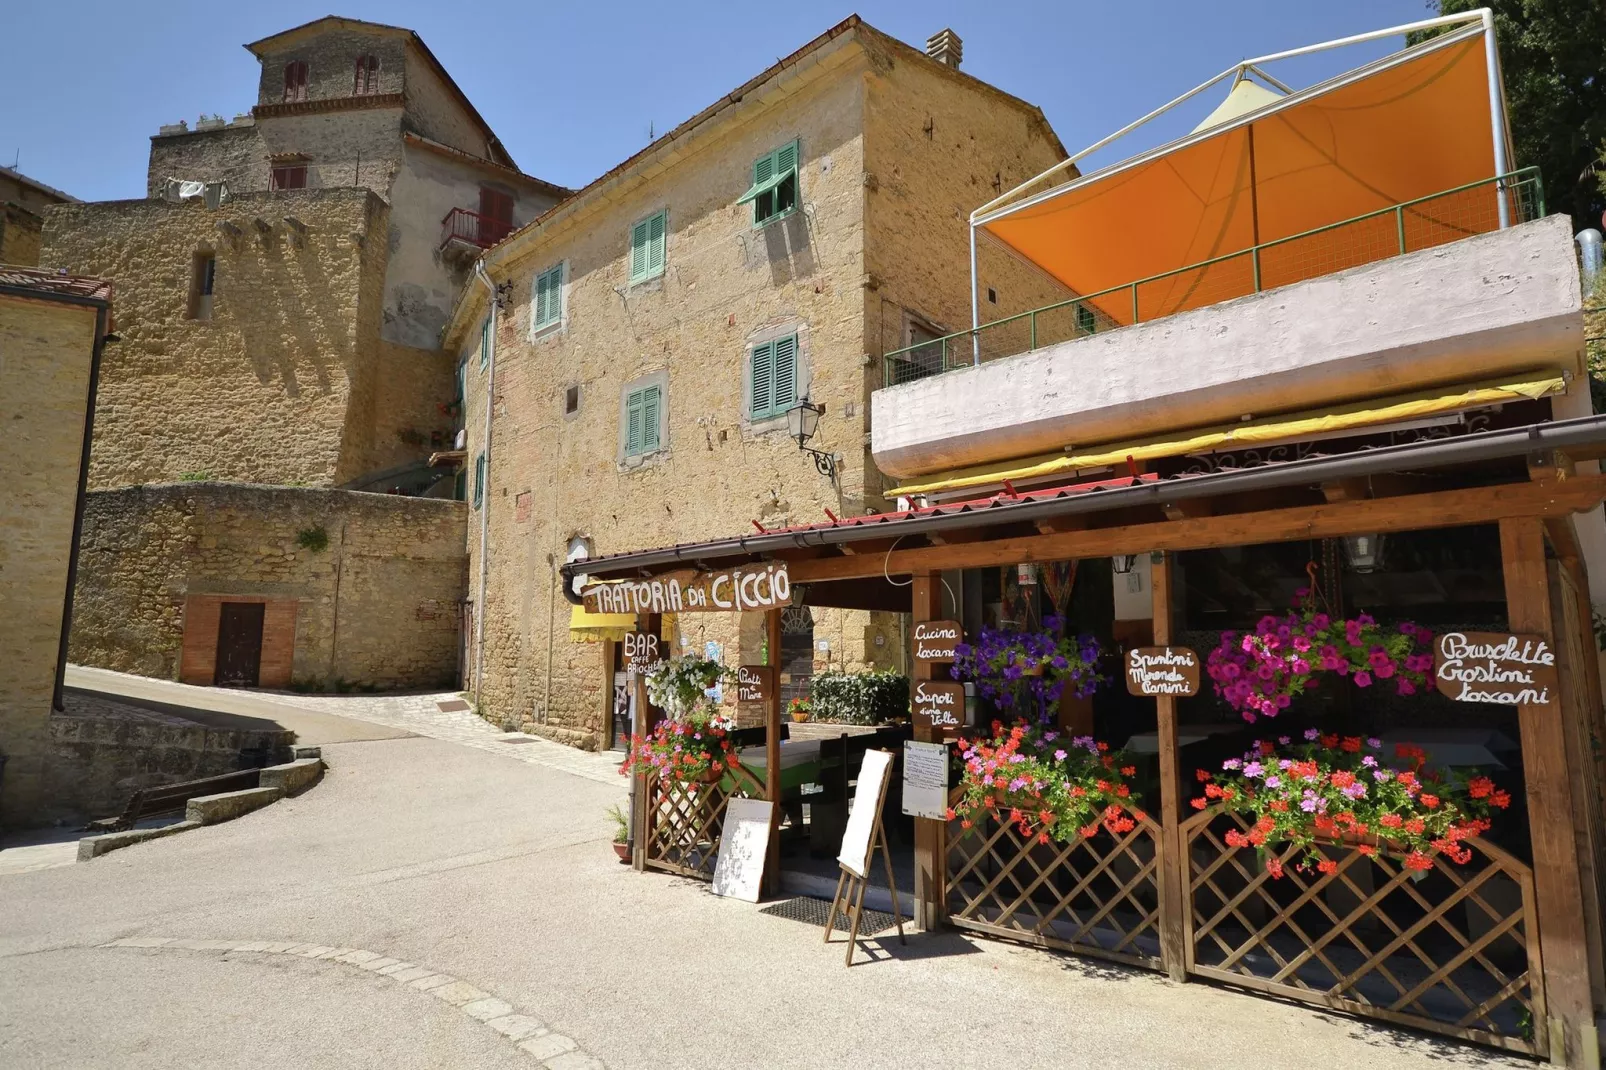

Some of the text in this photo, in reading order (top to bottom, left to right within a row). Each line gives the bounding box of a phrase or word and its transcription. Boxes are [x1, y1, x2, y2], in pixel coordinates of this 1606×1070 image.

[582, 578, 683, 614] TRATTORIA
[688, 588, 707, 607] DA
[624, 632, 658, 656] BAR
[914, 624, 957, 640] Cucina
[1130, 647, 1194, 674] Spuntini
[1441, 632, 1555, 666] Bruschette
[1129, 666, 1185, 683] Merenda
[1437, 659, 1535, 684] Crostini
[915, 682, 954, 709] Sapori
[1142, 680, 1191, 694] Panini
[1455, 682, 1550, 704] toscani
[930, 710, 959, 726] Volta
